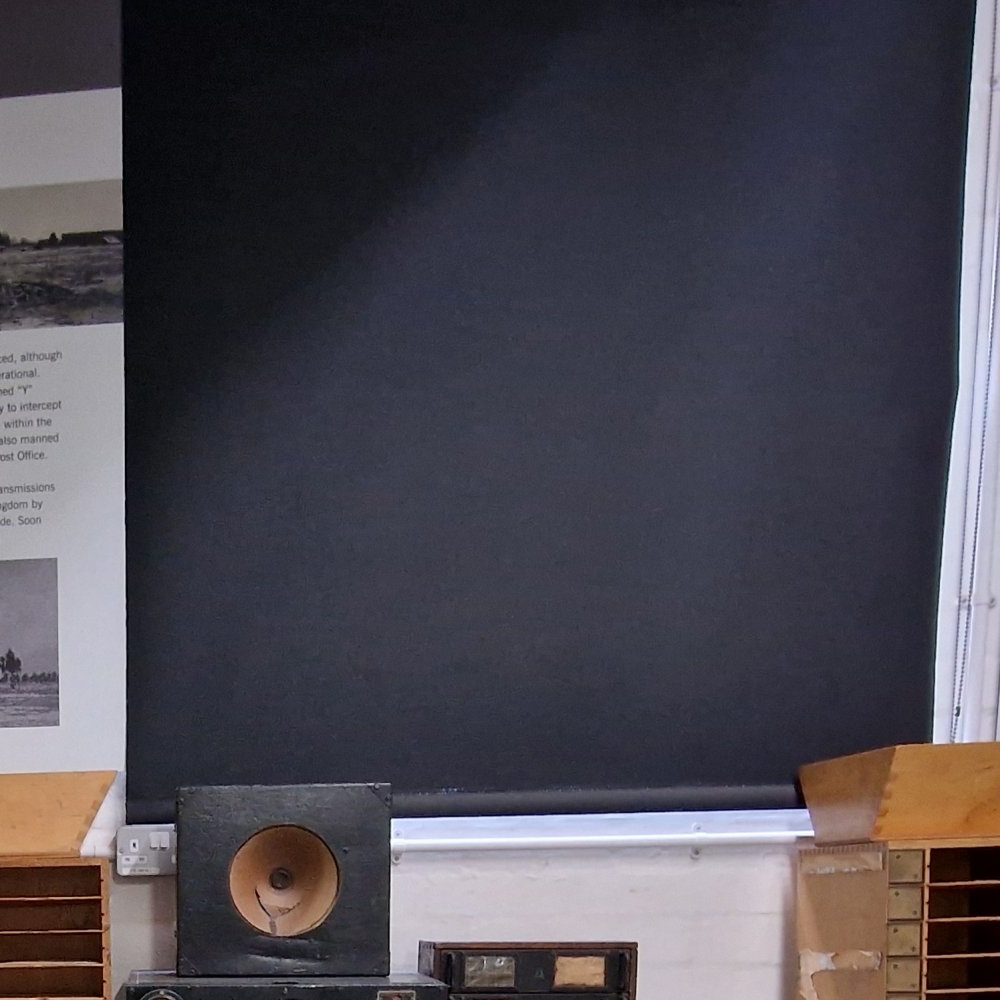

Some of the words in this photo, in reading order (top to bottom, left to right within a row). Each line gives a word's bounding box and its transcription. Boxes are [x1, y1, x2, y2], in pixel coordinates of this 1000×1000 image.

[20, 350, 62, 362] although
[7, 402, 17, 412] to
[20, 400, 62, 411] intercept
[4, 417, 34, 429] within
[37, 416, 52, 427] the
[20, 432, 60, 444] manned
[17, 449, 48, 461] Office.
[31, 499, 43, 511] by
[17, 515, 42, 526] Soon
